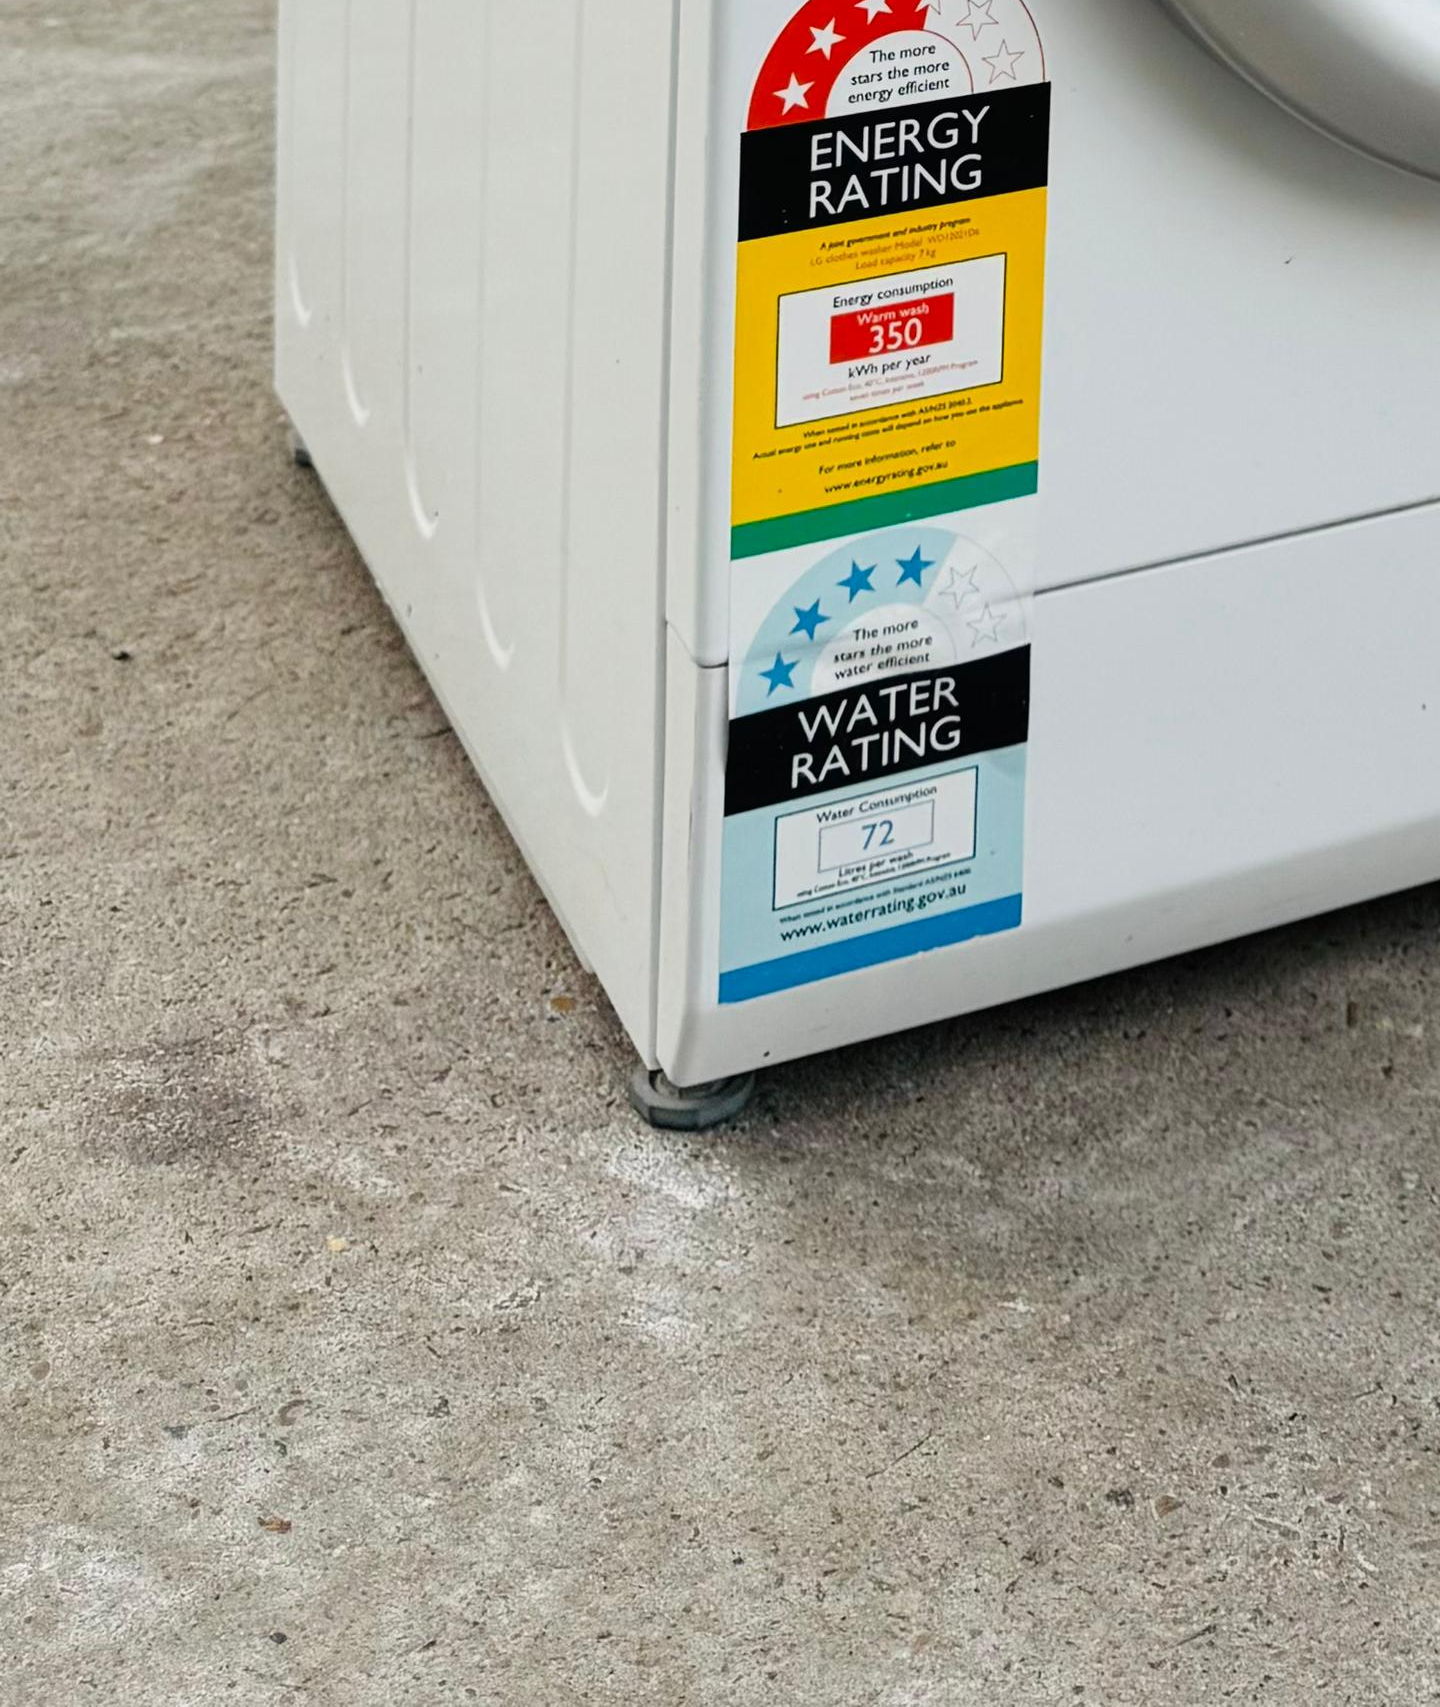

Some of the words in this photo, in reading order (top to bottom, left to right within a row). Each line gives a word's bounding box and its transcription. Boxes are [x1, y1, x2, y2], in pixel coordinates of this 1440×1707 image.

[870, 49, 895, 63] The
[900, 45, 936, 60] more
[851, 71, 883, 85] stars
[888, 66, 909, 79] the
[914, 61, 950, 76] more
[848, 88, 893, 103] energy
[898, 78, 950, 95] efficient
[810, 105, 990, 172] ENERGY
[809, 154, 982, 218] RATING
[855, 257, 878, 270] Load
[880, 252, 916, 267] capacity
[833, 293, 873, 308] Energy
[877, 277, 953, 300] consumption
[857, 309, 896, 326] Warm
[899, 302, 930, 317] wash
[868, 317, 923, 354] 350
[848, 363, 878, 379] kWh
[881, 360, 902, 375] per
[905, 354, 931, 371] year
[819, 464, 834, 475] For
[837, 459, 862, 471] more
[921, 441, 943, 454] refer
[945, 440, 956, 448] to
[853, 628, 878, 641] The
[882, 620, 918, 635] more
[834, 650, 865, 663] stars
[871, 643, 892, 656] the
[896, 636, 933, 651] more
[835, 662, 873, 680] water
[877, 652, 930, 669] efficient
[798, 676, 959, 743] WATER
[791, 715, 961, 789] RATING
[816, 806, 854, 823] Water
[859, 786, 937, 813] Consumption
[862, 820, 894, 850] 72
[839, 865, 866, 878] Litres
[870, 860, 886, 872] per
[889, 851, 914, 864] wash
[780, 884, 967, 942] www.waterrating.gov.au
